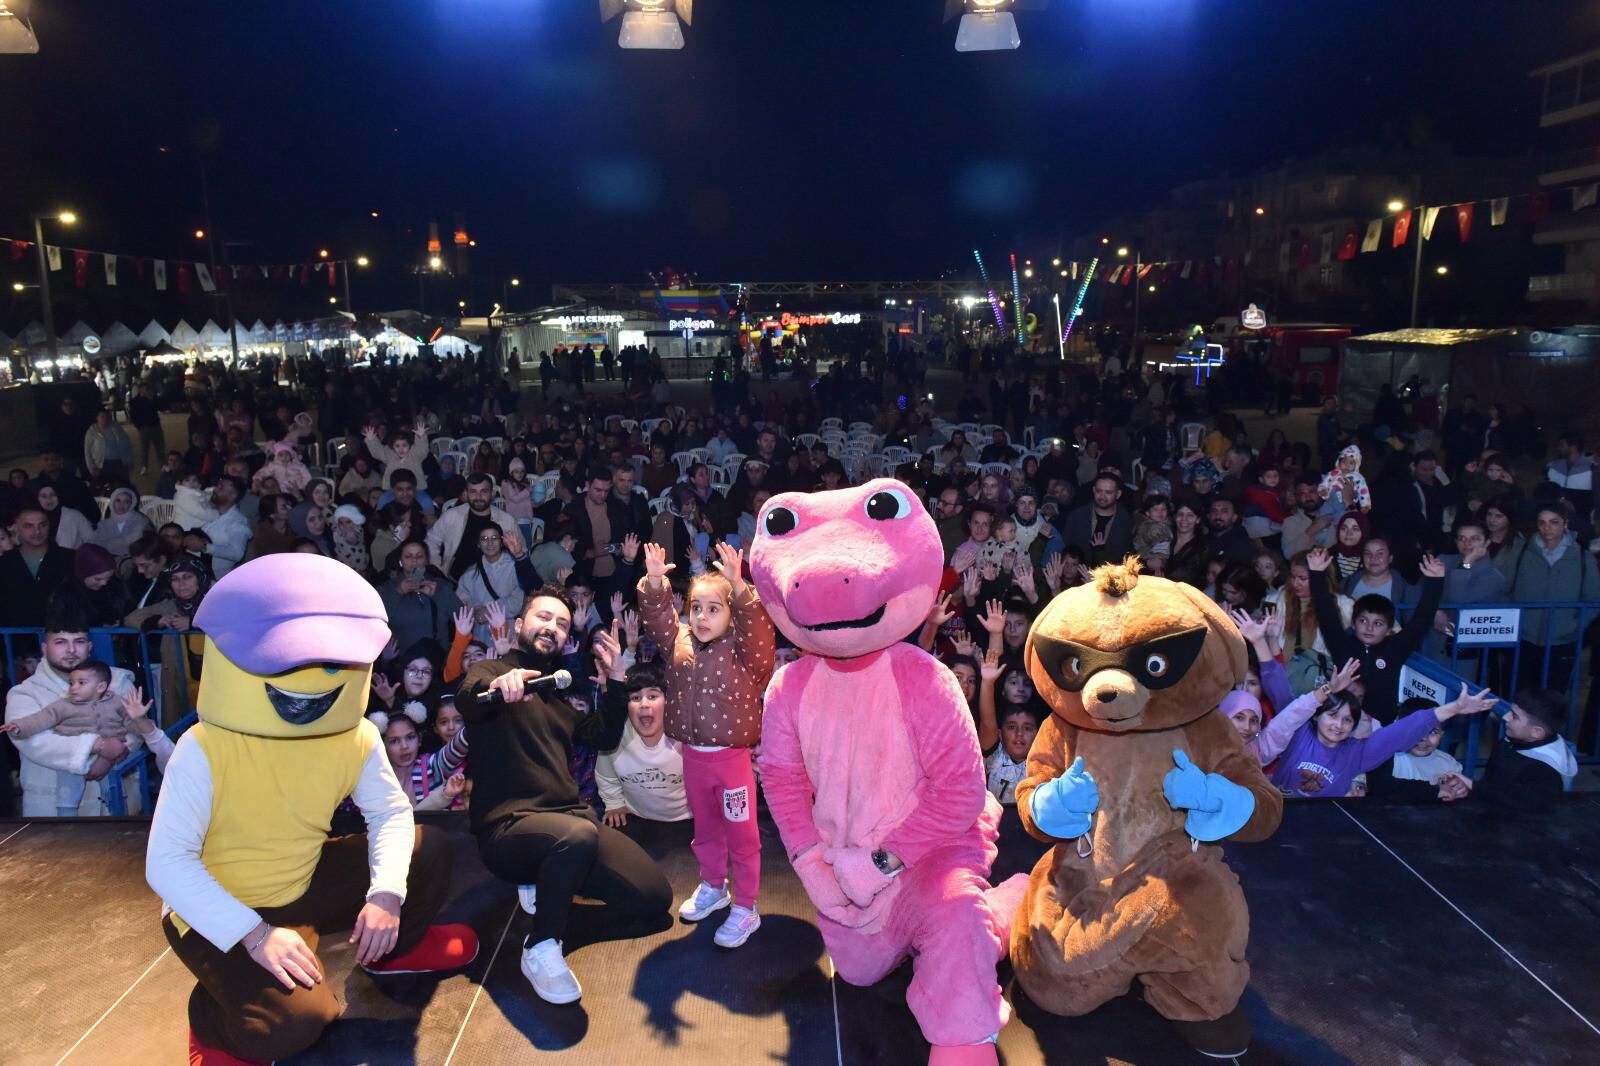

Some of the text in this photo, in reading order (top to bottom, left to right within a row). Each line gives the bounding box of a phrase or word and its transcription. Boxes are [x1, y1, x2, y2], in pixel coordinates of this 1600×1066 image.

[669, 317, 715, 331] poligon
[781, 312, 861, 326] Bumper Cars
[1469, 616, 1502, 624] KEPEZ
[1458, 625, 1514, 636] BELEDİYESİ
[1411, 678, 1437, 699] KEPEZ
[999, 779, 1010, 800] 7
